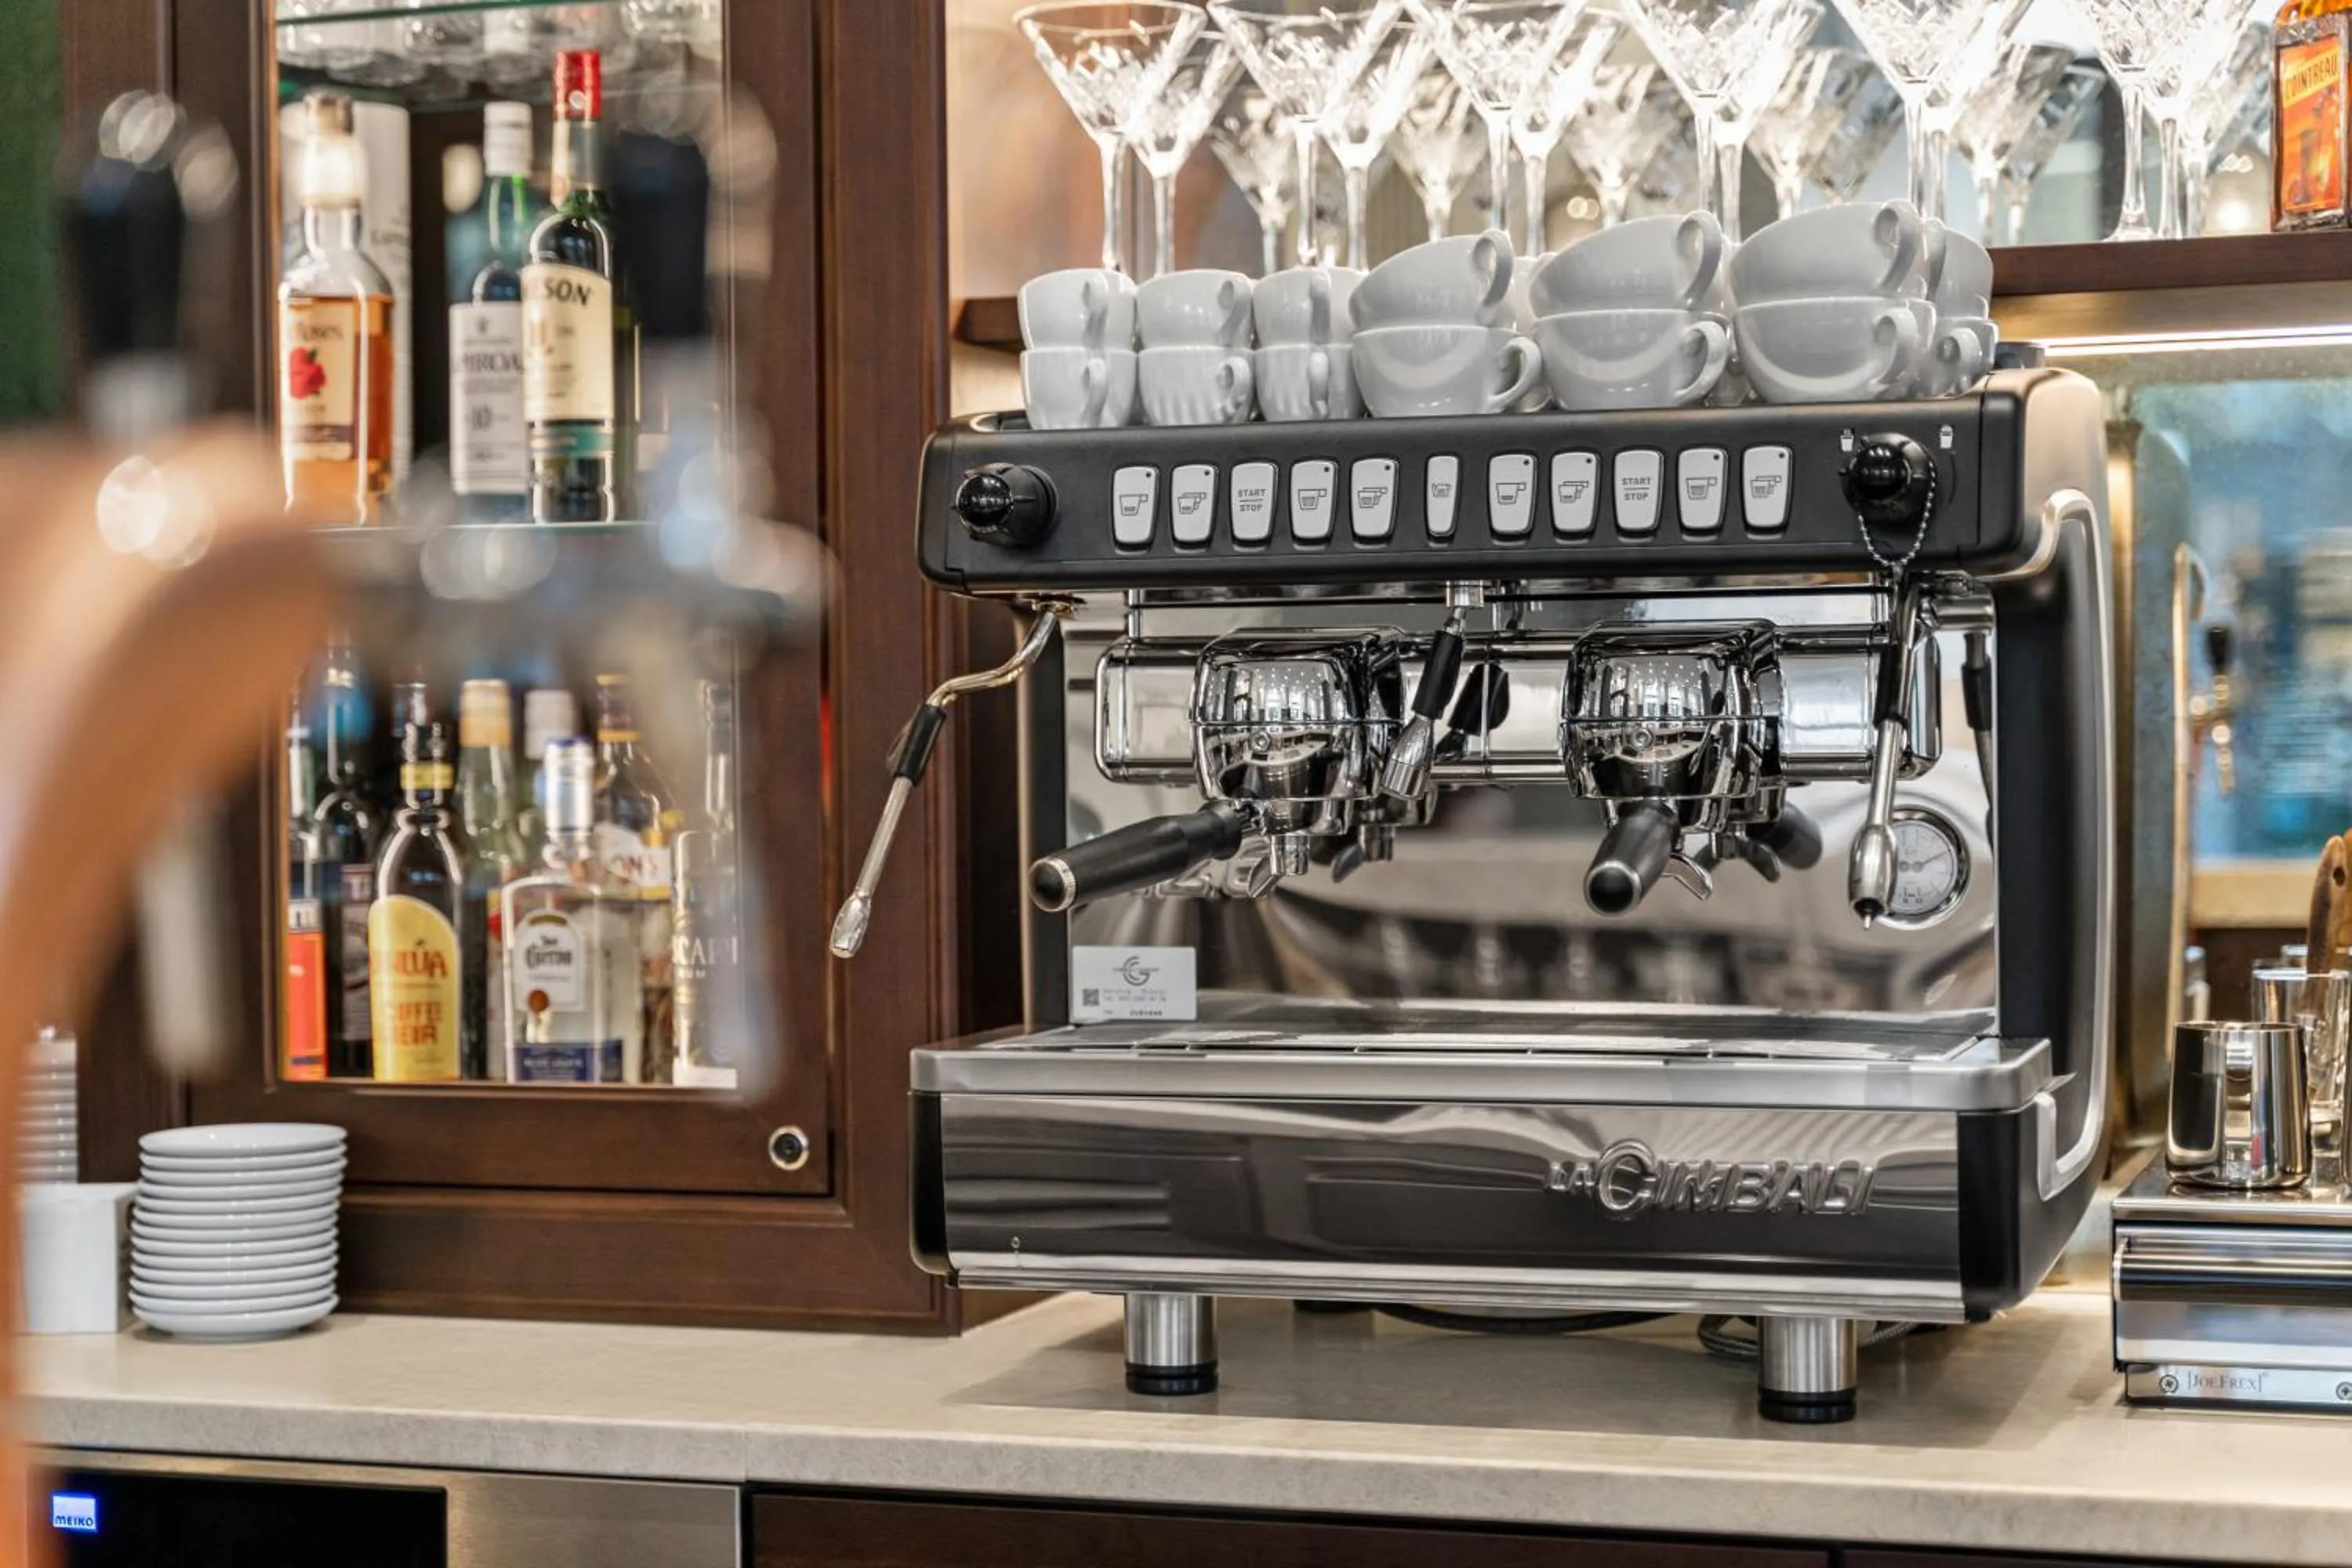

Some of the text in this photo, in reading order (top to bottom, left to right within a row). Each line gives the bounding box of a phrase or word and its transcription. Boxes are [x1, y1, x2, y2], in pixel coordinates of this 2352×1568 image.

[2285, 53, 2339, 100] COINTREAU
[1621, 477, 1650, 486] START
[1237, 488, 1267, 498] START
[1624, 492, 1649, 501] STOP
[1596, 1138, 1875, 1221] CIMBALI
[55, 1515, 94, 1527] MEIKO
